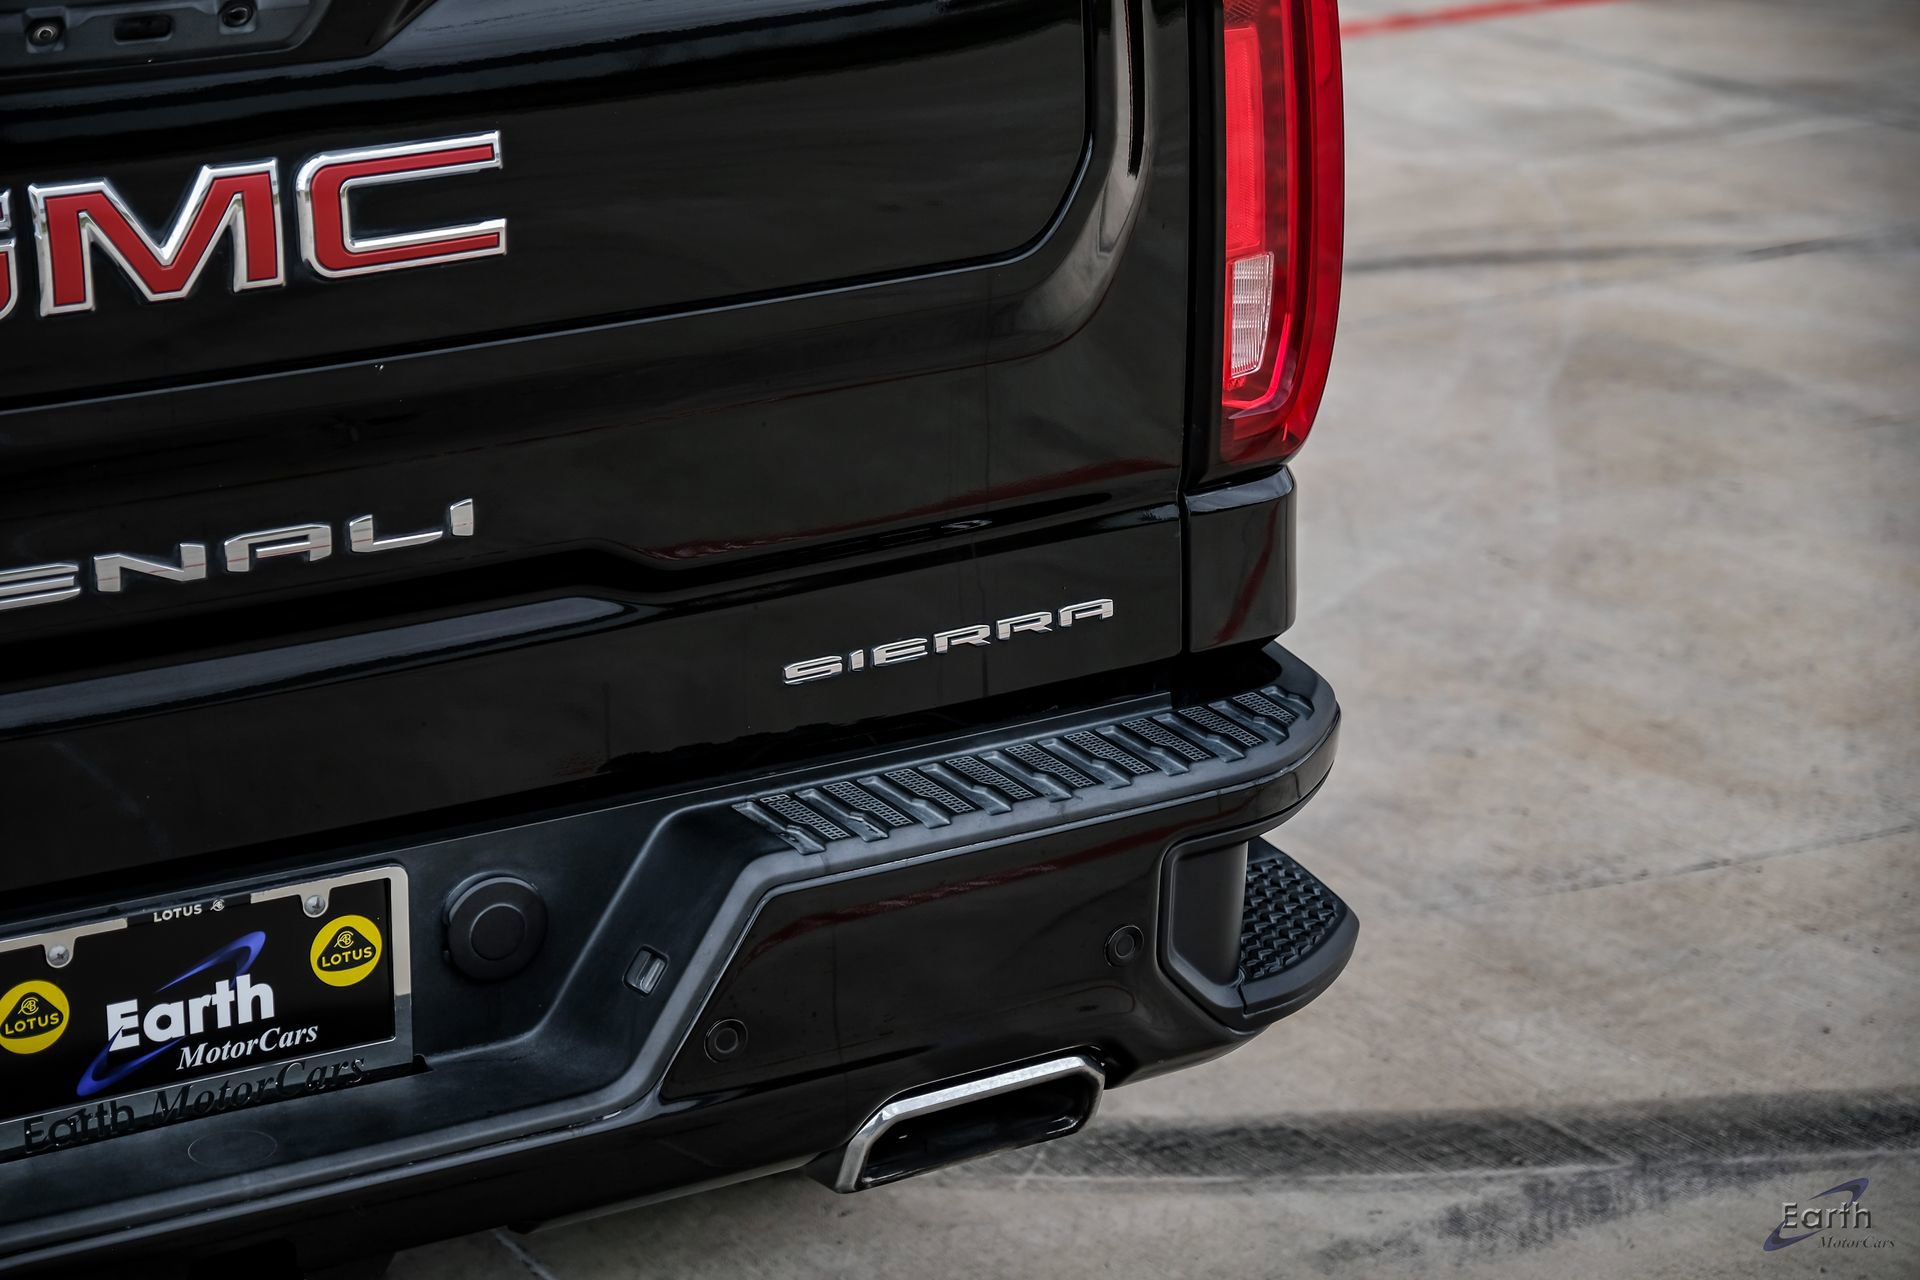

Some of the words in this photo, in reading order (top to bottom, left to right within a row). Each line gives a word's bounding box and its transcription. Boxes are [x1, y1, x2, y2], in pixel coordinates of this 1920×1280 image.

[0, 130, 507, 319] MC
[783, 598, 1114, 686] SIERRA
[153, 903, 203, 923] LOTUS
[321, 946, 374, 968] LOTUS
[4, 1011, 60, 1037] LOTUS
[106, 974, 275, 1053] Earth
[176, 1023, 319, 1072] MotorCars
[24, 1101, 136, 1154] Earth
[151, 1057, 366, 1122] MotorCars
